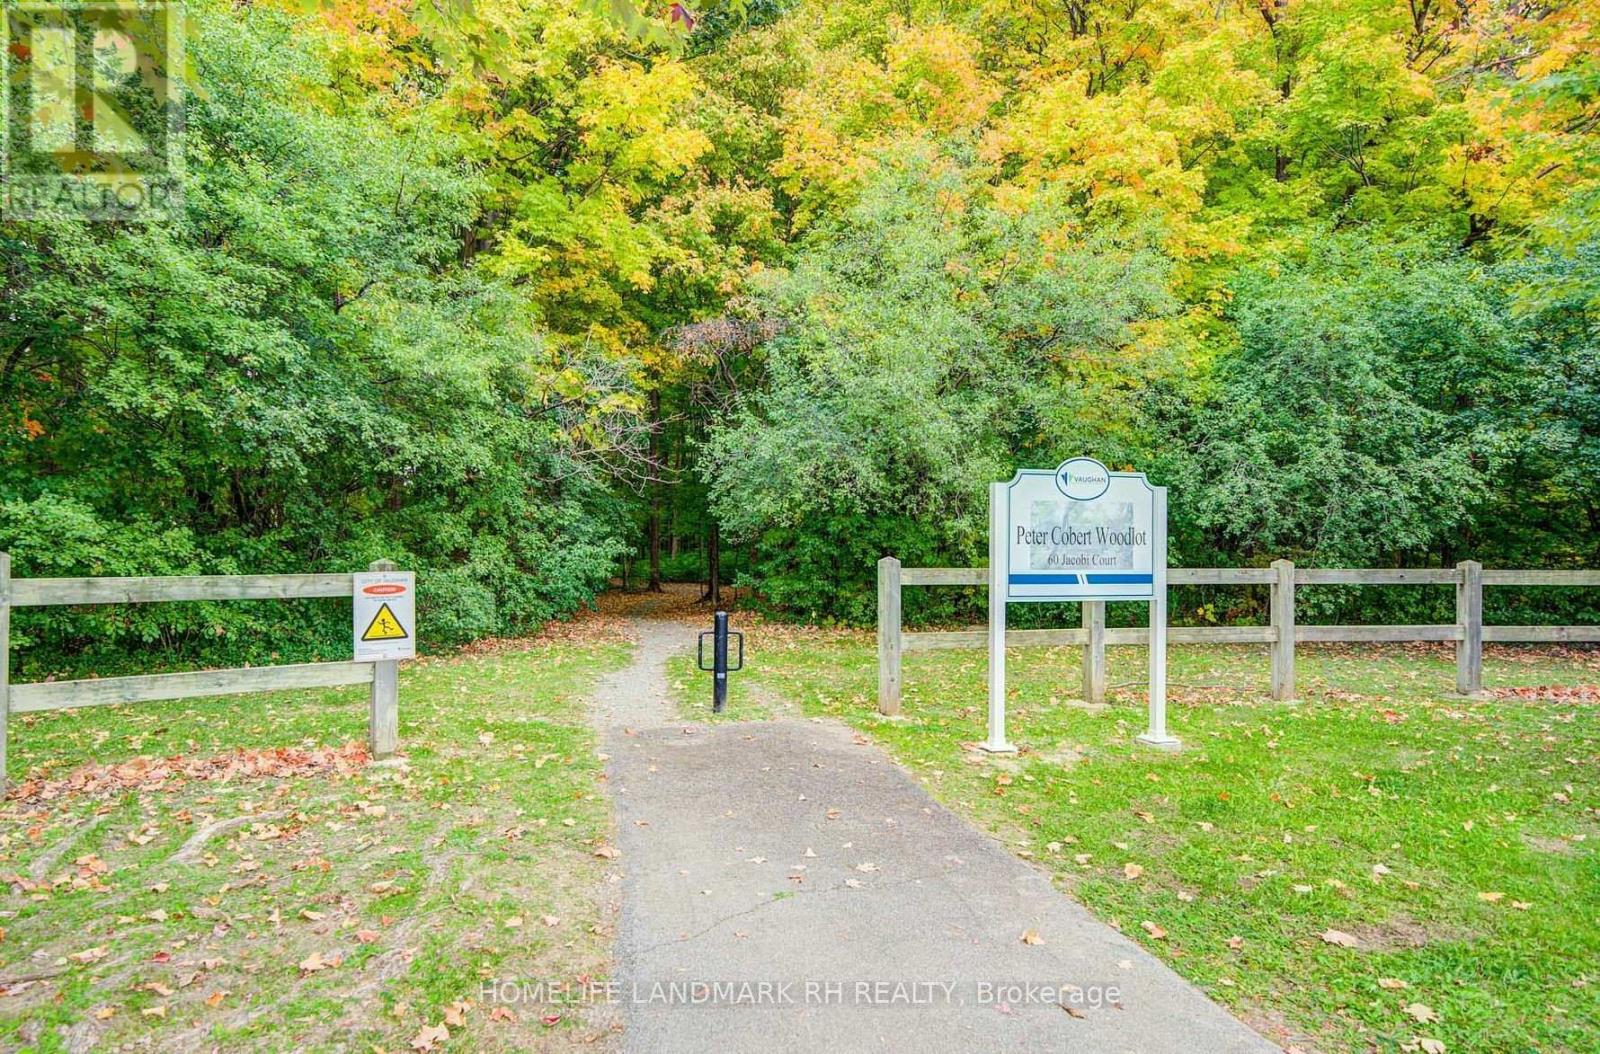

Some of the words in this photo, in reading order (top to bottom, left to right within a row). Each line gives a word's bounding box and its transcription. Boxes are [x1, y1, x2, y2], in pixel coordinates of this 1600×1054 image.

[1074, 476, 1106, 484] VAUGHAN
[1016, 525, 1049, 546] Peter
[1051, 525, 1092, 546] Cobert
[1096, 526, 1147, 546] Woodlot
[1047, 554, 1059, 565] 60
[1061, 553, 1090, 566] Jacobi
[1092, 554, 1117, 566] Court
